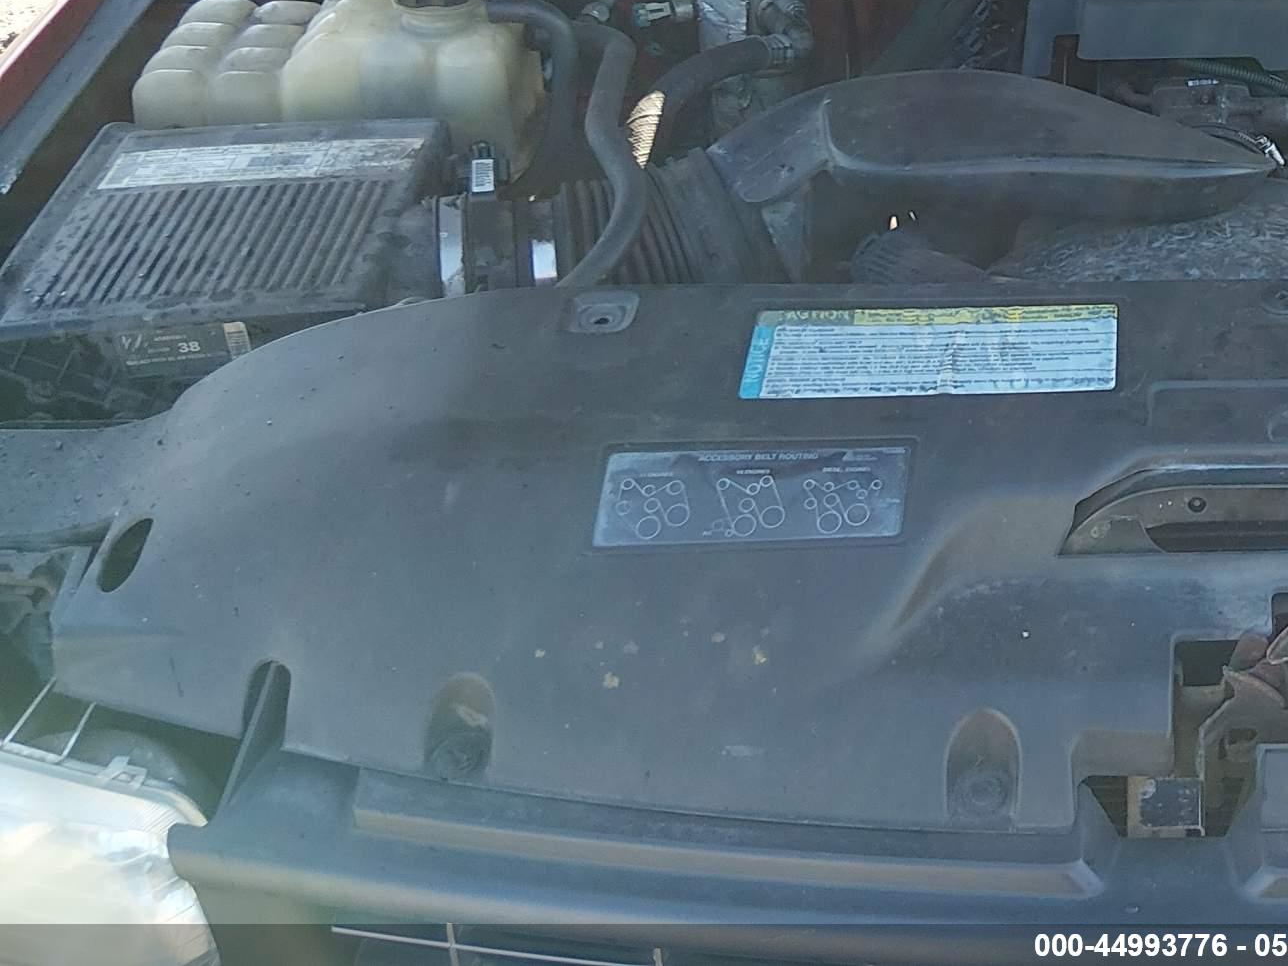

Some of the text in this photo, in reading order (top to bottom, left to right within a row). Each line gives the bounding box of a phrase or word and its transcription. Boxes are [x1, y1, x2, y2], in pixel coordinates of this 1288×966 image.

[178, 342, 200, 354] 38
[744, 337, 769, 383] NOTICE
[698, 452, 818, 462] ACCESSORY BELT ROUTING
